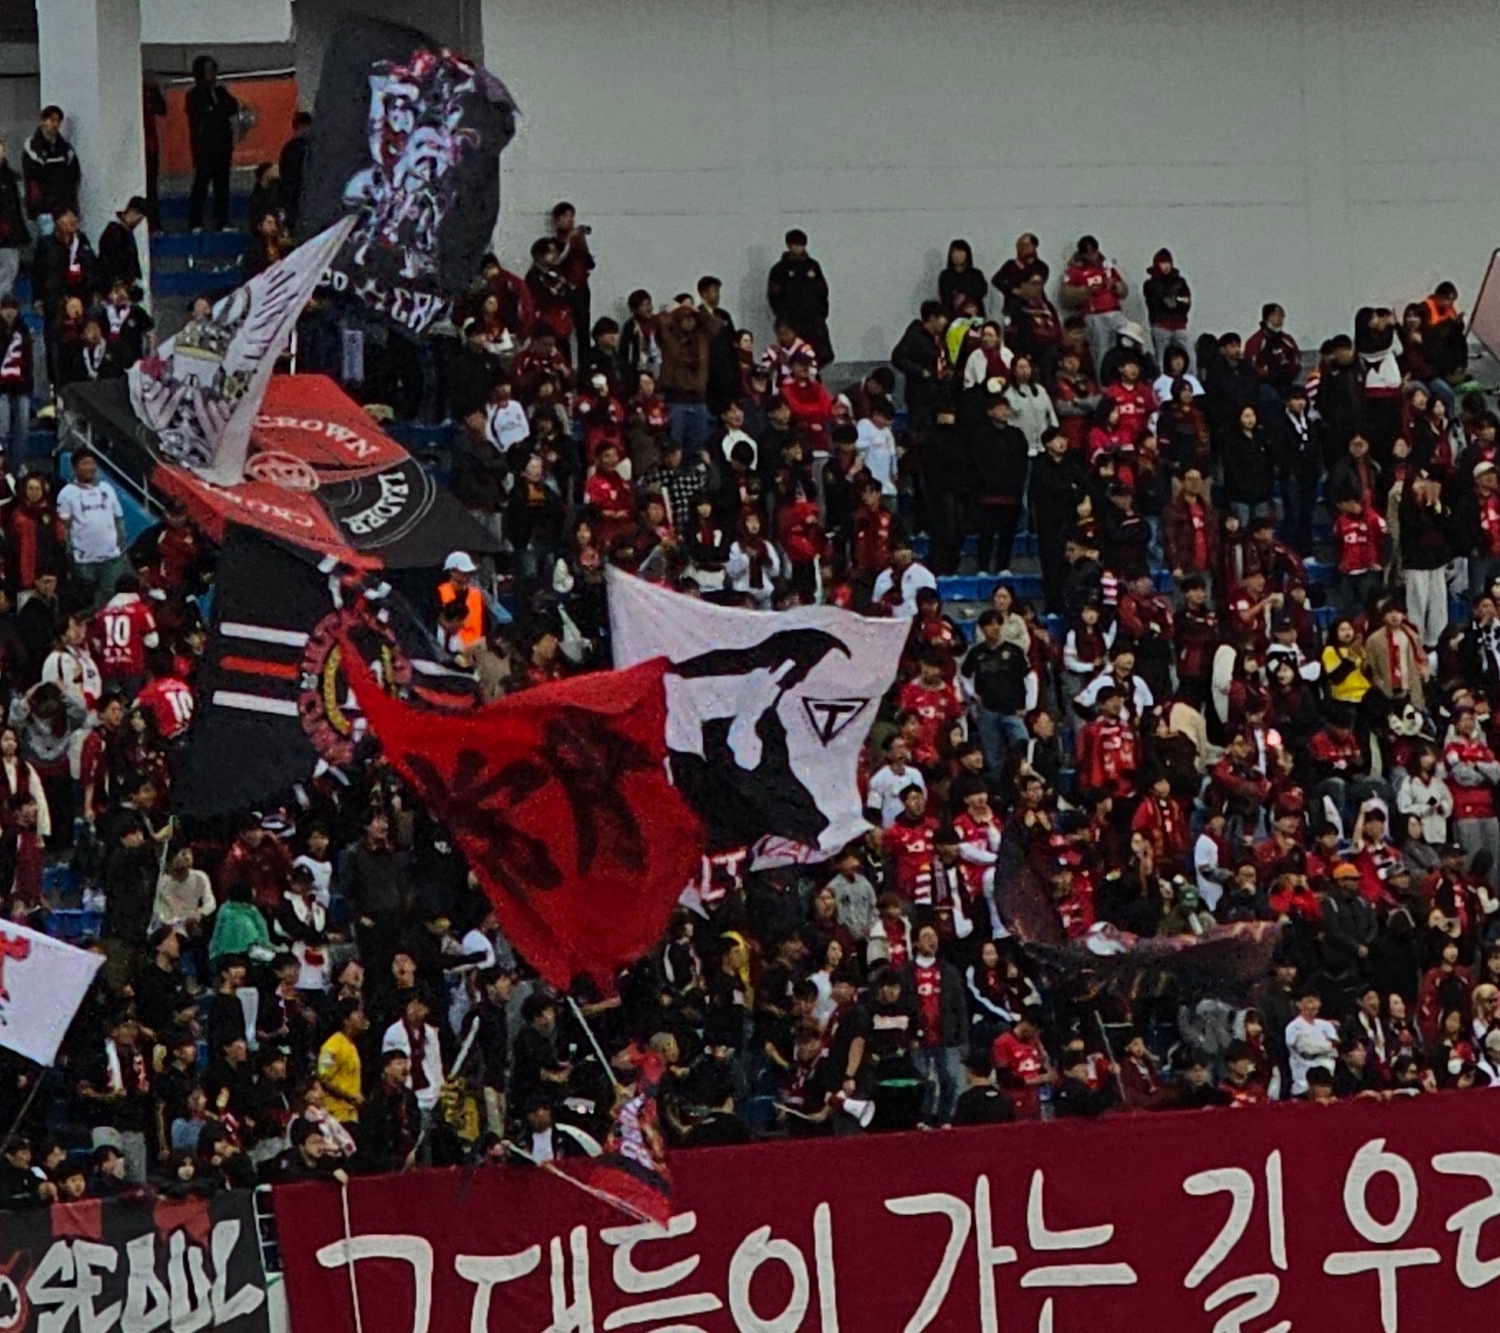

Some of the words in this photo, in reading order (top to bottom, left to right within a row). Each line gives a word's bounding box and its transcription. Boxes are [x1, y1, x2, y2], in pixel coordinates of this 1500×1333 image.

[104, 614, 131, 647] 10
[884, 1169, 1138, 1333] 가는
[1183, 1148, 1293, 1333] 길
